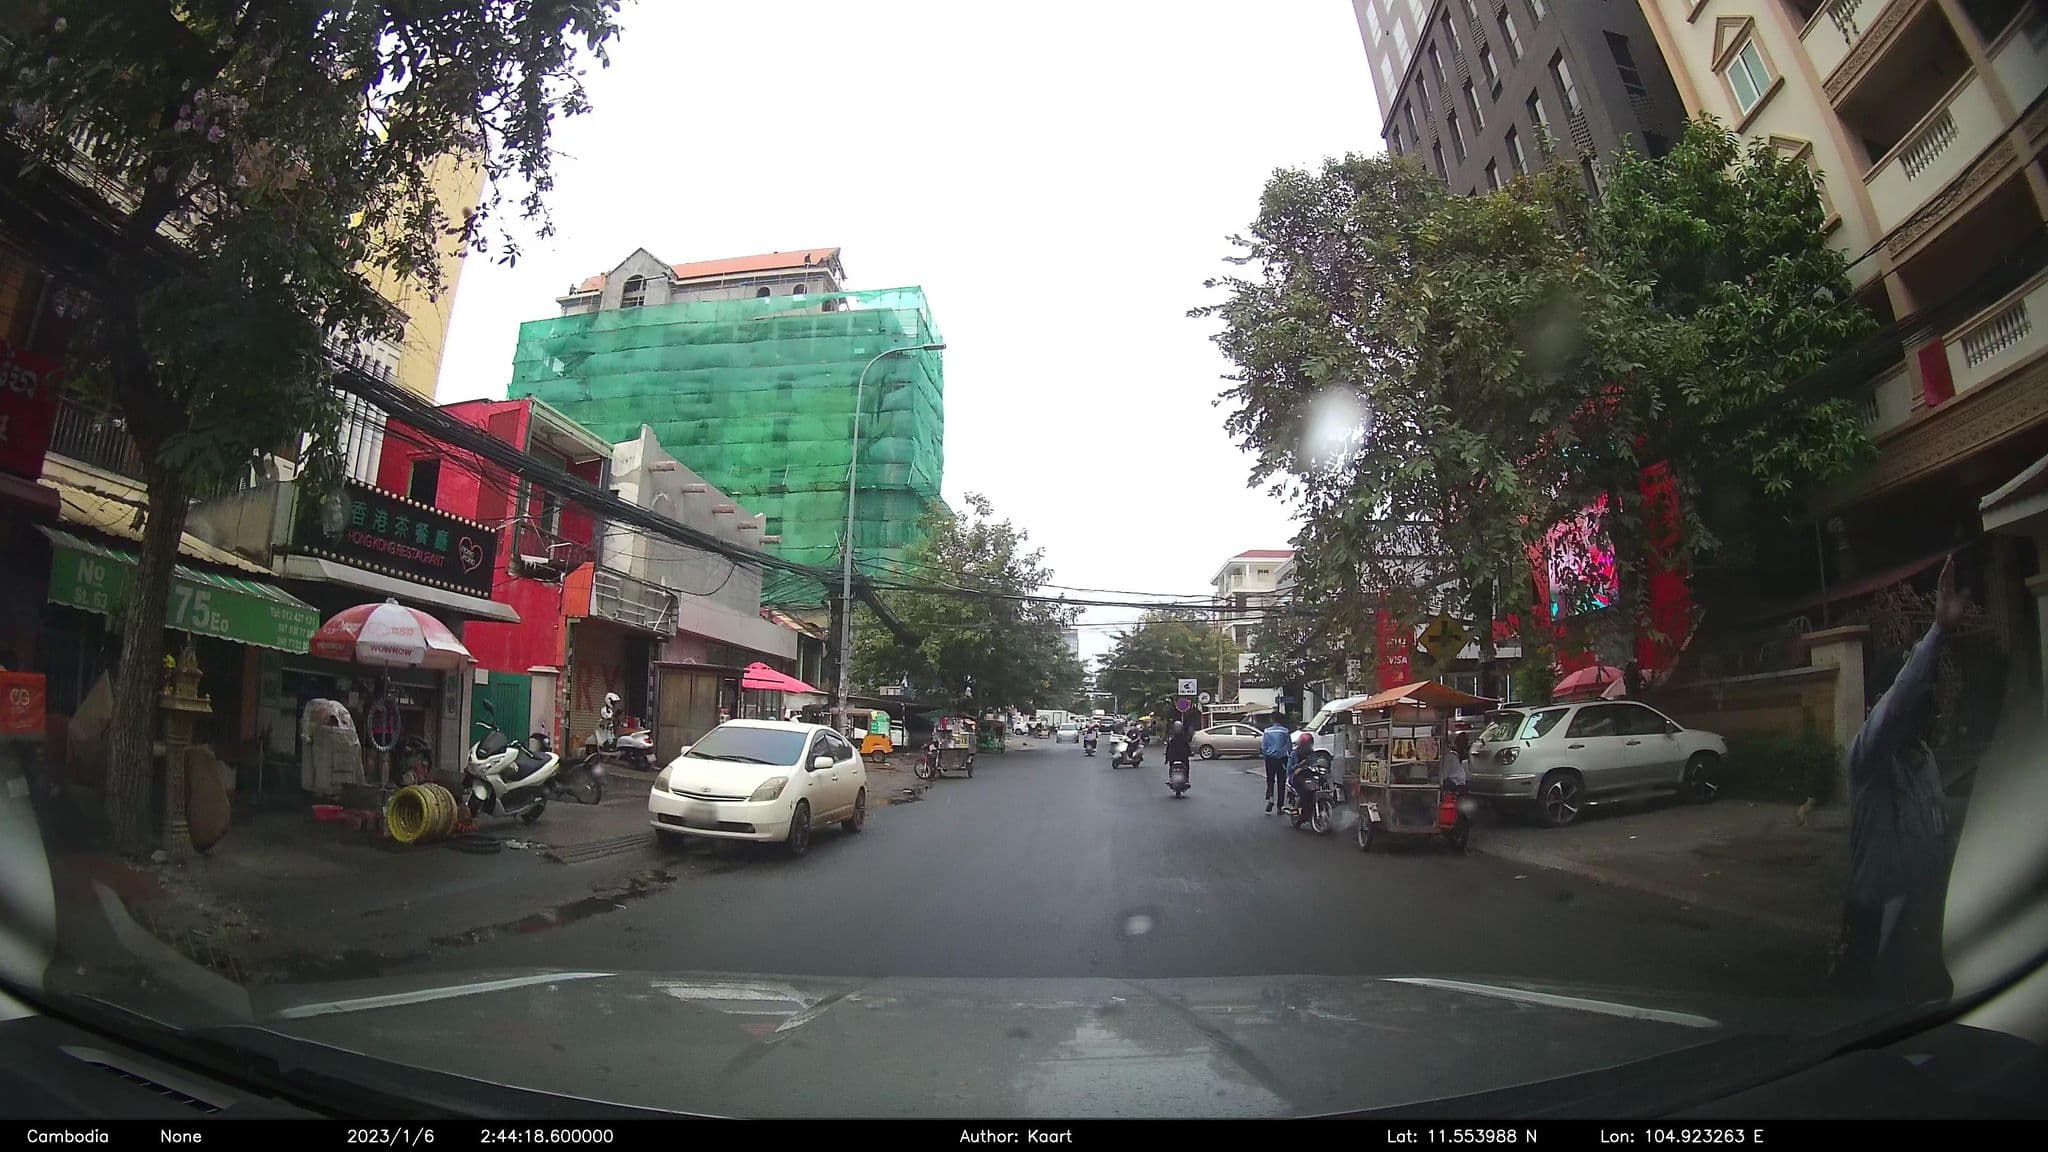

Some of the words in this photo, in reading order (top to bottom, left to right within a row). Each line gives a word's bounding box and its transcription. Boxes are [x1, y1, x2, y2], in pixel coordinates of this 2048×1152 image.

[351, 501, 449, 551] 香港茶餐廳
[347, 529, 371, 548] HONG
[396, 543, 446, 567] RESTAURANT
[370, 645, 413, 657] WOWNOW
